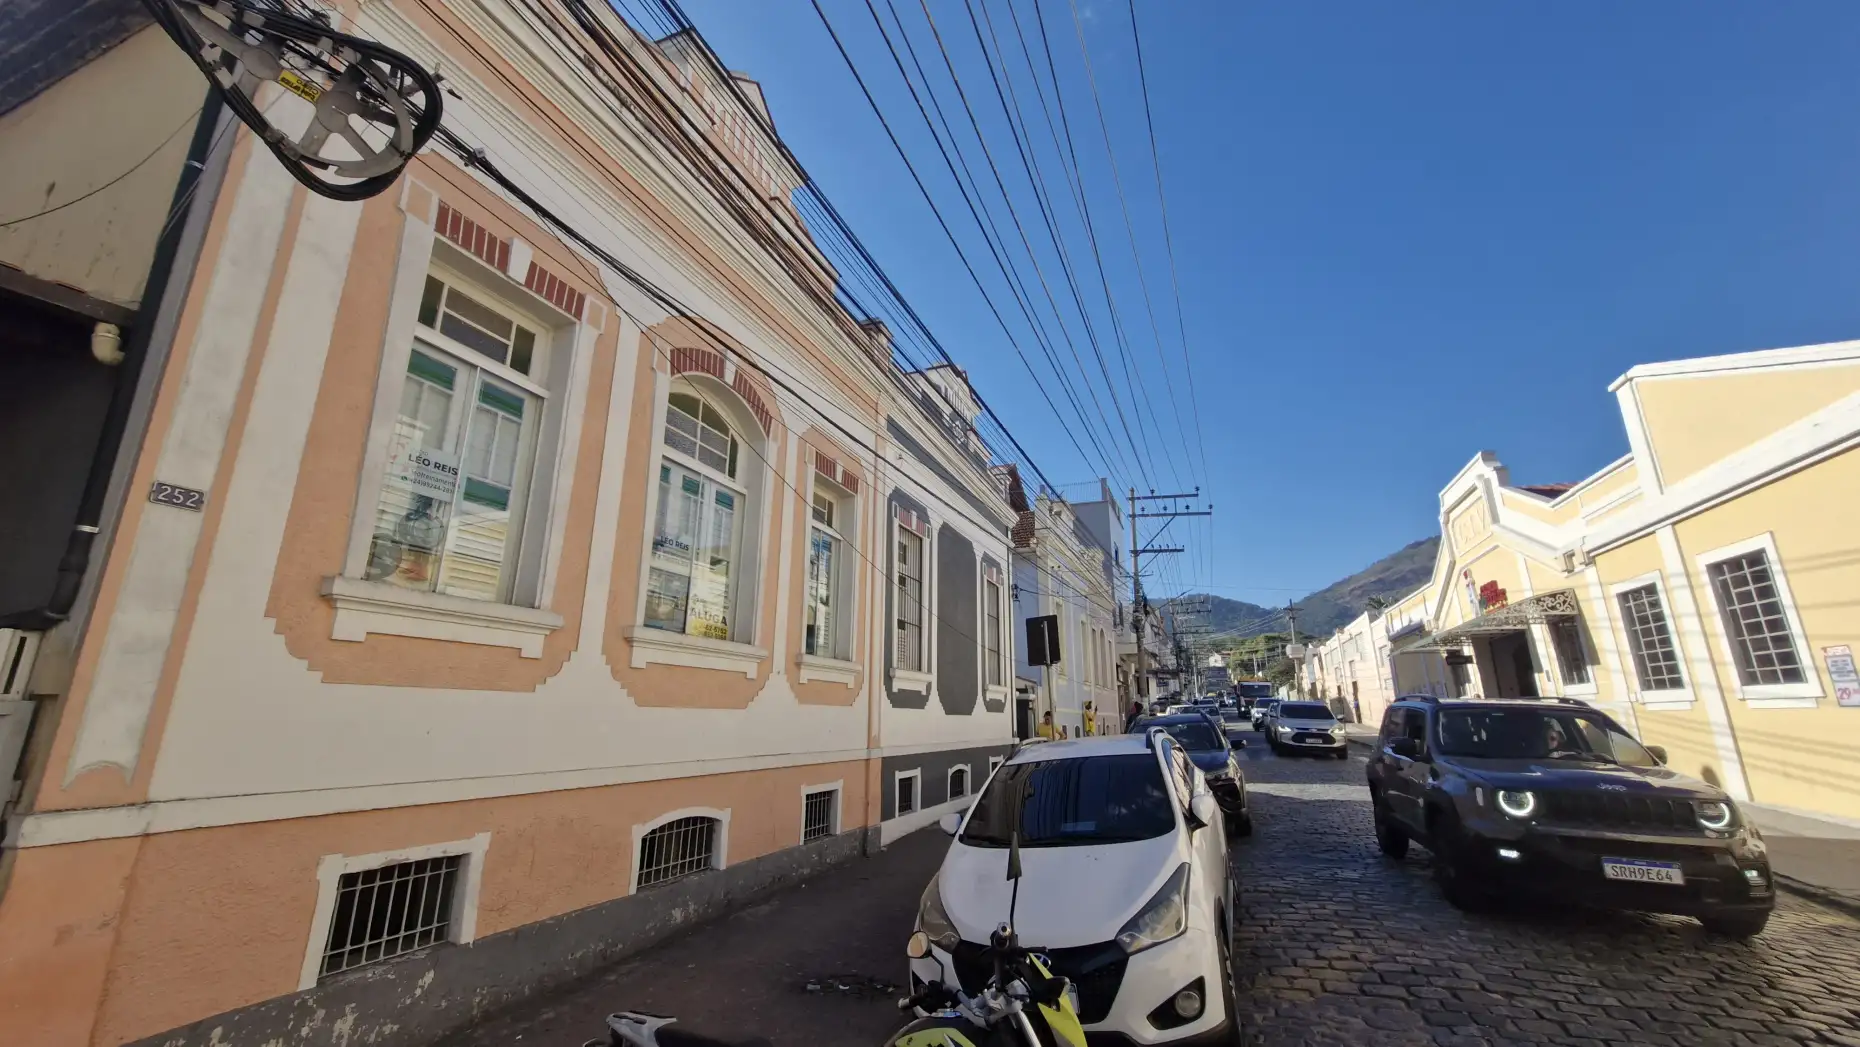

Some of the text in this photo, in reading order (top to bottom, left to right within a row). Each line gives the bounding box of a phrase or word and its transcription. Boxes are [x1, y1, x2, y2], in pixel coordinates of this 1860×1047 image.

[408, 453, 459, 476] LÉO REIS
[157, 485, 200, 507] 252
[675, 541, 690, 552] REIS
[689, 607, 728, 627] ALUGA
[1610, 865, 1673, 882] SRH9E64
